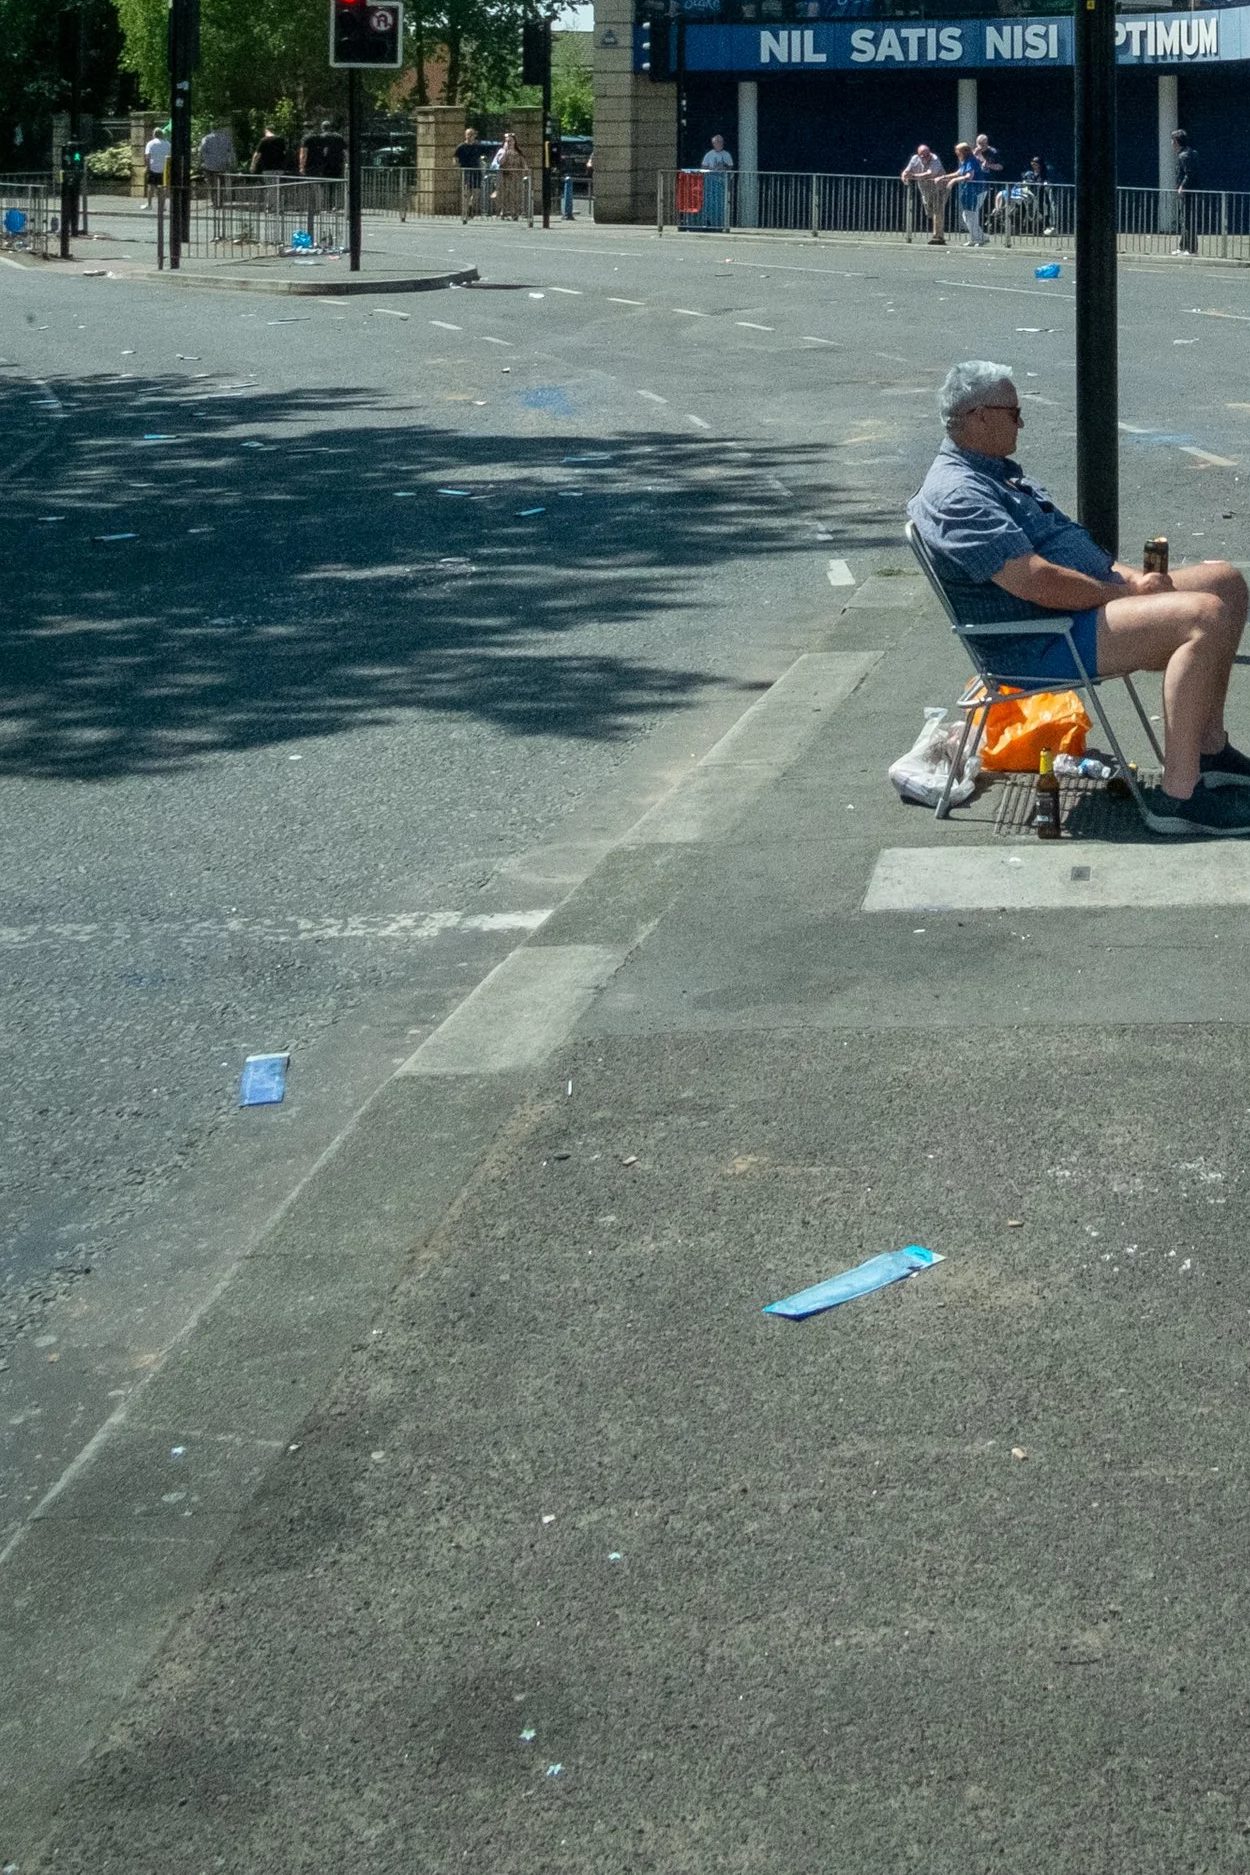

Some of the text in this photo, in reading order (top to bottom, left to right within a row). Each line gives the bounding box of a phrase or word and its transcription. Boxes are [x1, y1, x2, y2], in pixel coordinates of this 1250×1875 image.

[759, 18, 1217, 63] NIL SATIS NISI PTIMUM
